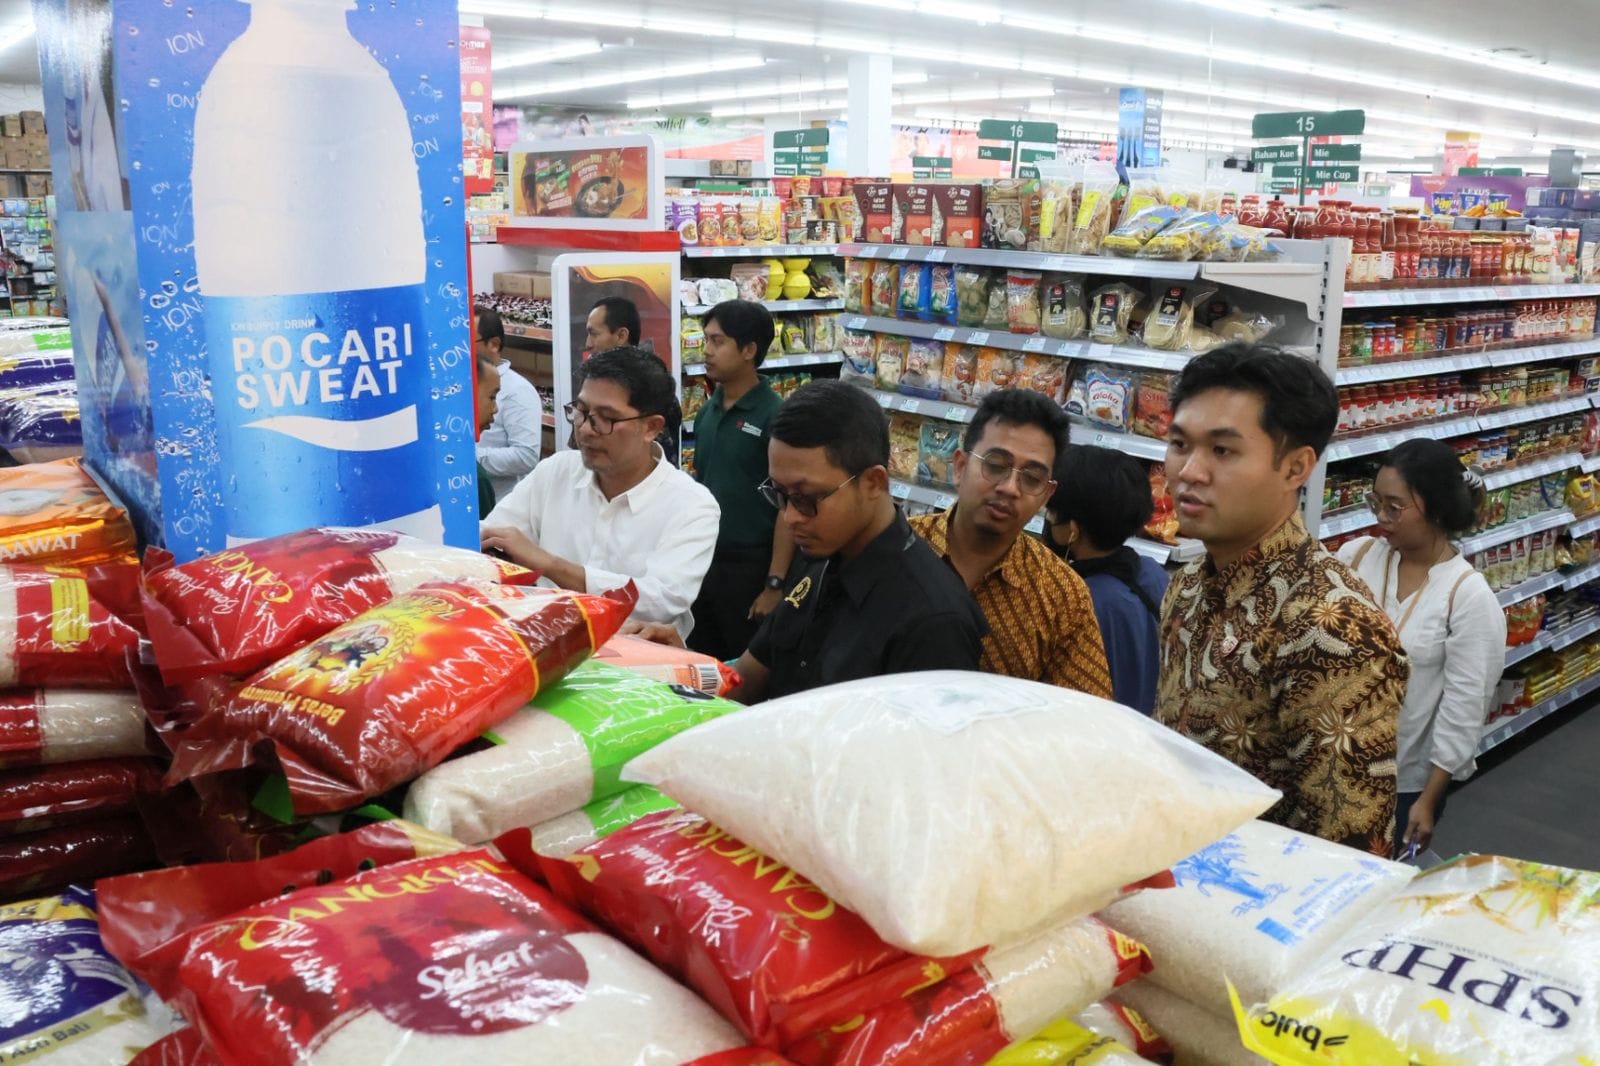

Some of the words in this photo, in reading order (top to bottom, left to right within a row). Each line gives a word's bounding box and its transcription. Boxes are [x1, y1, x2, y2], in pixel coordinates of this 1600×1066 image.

[166, 30, 205, 55] ION
[167, 93, 194, 108] ION
[1010, 124, 1024, 138] 16
[1296, 116, 1315, 132] 15
[795, 132, 805, 144] 17
[412, 137, 439, 158] ON
[1254, 150, 1278, 159] Bahan
[1279, 149, 1295, 158] Kue
[1314, 148, 1329, 157] Mie
[1315, 170, 1331, 179] Mie
[1333, 170, 1351, 181] Cup
[151, 181, 170, 194] ION
[141, 224, 178, 243] ION
[162, 296, 203, 331] ION
[284, 317, 316, 330] DRINK
[232, 323, 413, 373] POCARI
[438, 340, 471, 371] ION
[236, 359, 403, 410] SWEAT
[447, 474, 472, 490] ION
[299, 696, 346, 726] Beras
[417, 941, 534, 1000] Sehat
[1341, 938, 1582, 1030] SPHP
